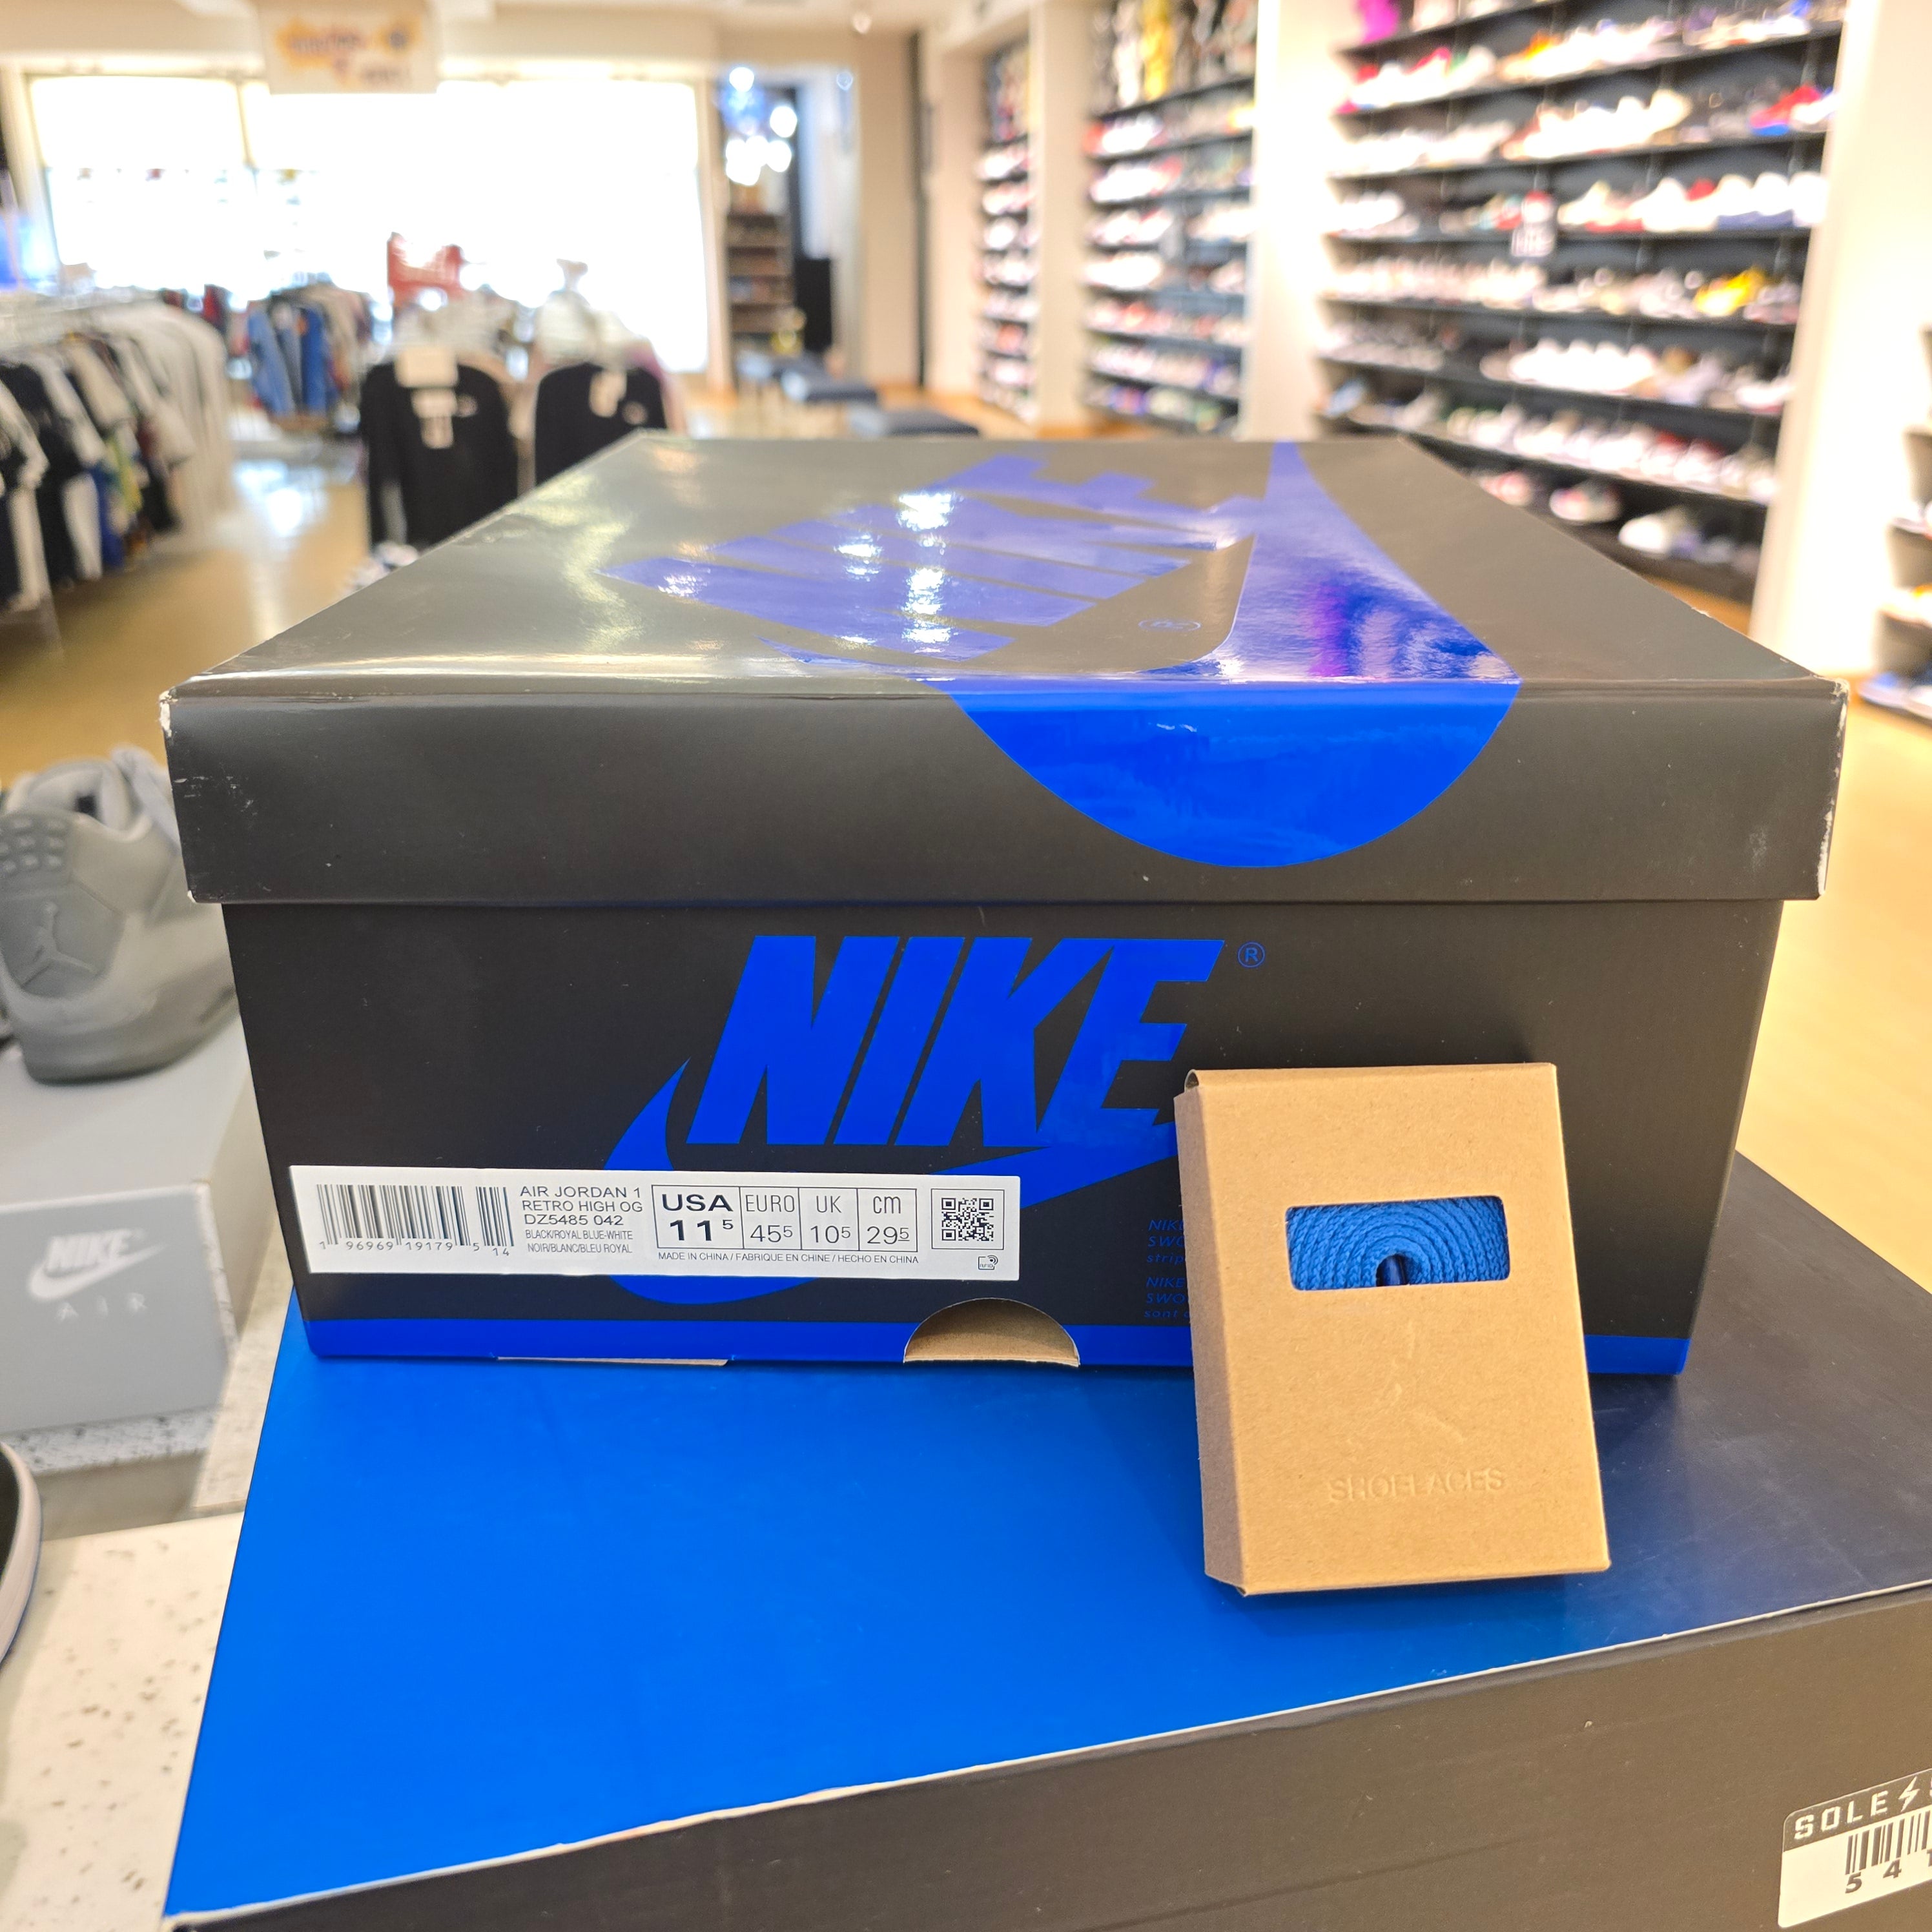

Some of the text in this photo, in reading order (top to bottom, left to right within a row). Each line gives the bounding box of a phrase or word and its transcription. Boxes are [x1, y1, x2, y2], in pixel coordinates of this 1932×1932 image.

[686, 935, 1225, 1147] NIKE
[520, 1186, 641, 1198] AIR JORDAN 1
[522, 1200, 643, 1213] RETRO HIGH OG
[662, 1193, 734, 1212] USA
[745, 1195, 796, 1213] EURO
[816, 1195, 842, 1213] UK
[873, 1195, 901, 1214] cm
[524, 1214, 624, 1226] DZ5485 042
[525, 1229, 633, 1240] BLACK/ROYAL BLUE-WHITE
[345, 1241, 394, 1251] 96969
[405, 1242, 453, 1251] 19179
[527, 1242, 633, 1254] NOIR/BLANC/BLEU ROYAL
[1148, 1235, 1185, 1248] SWO
[658, 1251, 685, 1260] MADE
[688, 1252, 697, 1260] IN
[699, 1252, 729, 1261] CHINA
[735, 1253, 783, 1262] FABRIQUE
[786, 1253, 799, 1262] EN
[801, 1254, 830, 1262] CHINE
[838, 1254, 872, 1263] HECHO
[874, 1255, 887, 1264] EN
[889, 1255, 920, 1264] CHINA
[1147, 1253, 1185, 1265] strip
[1146, 1277, 1186, 1288] NIKE
[1146, 1293, 1188, 1304] SWO
[1328, 1468, 1503, 1503] SHOELACES
[1794, 1791, 1889, 1840] SOLE
